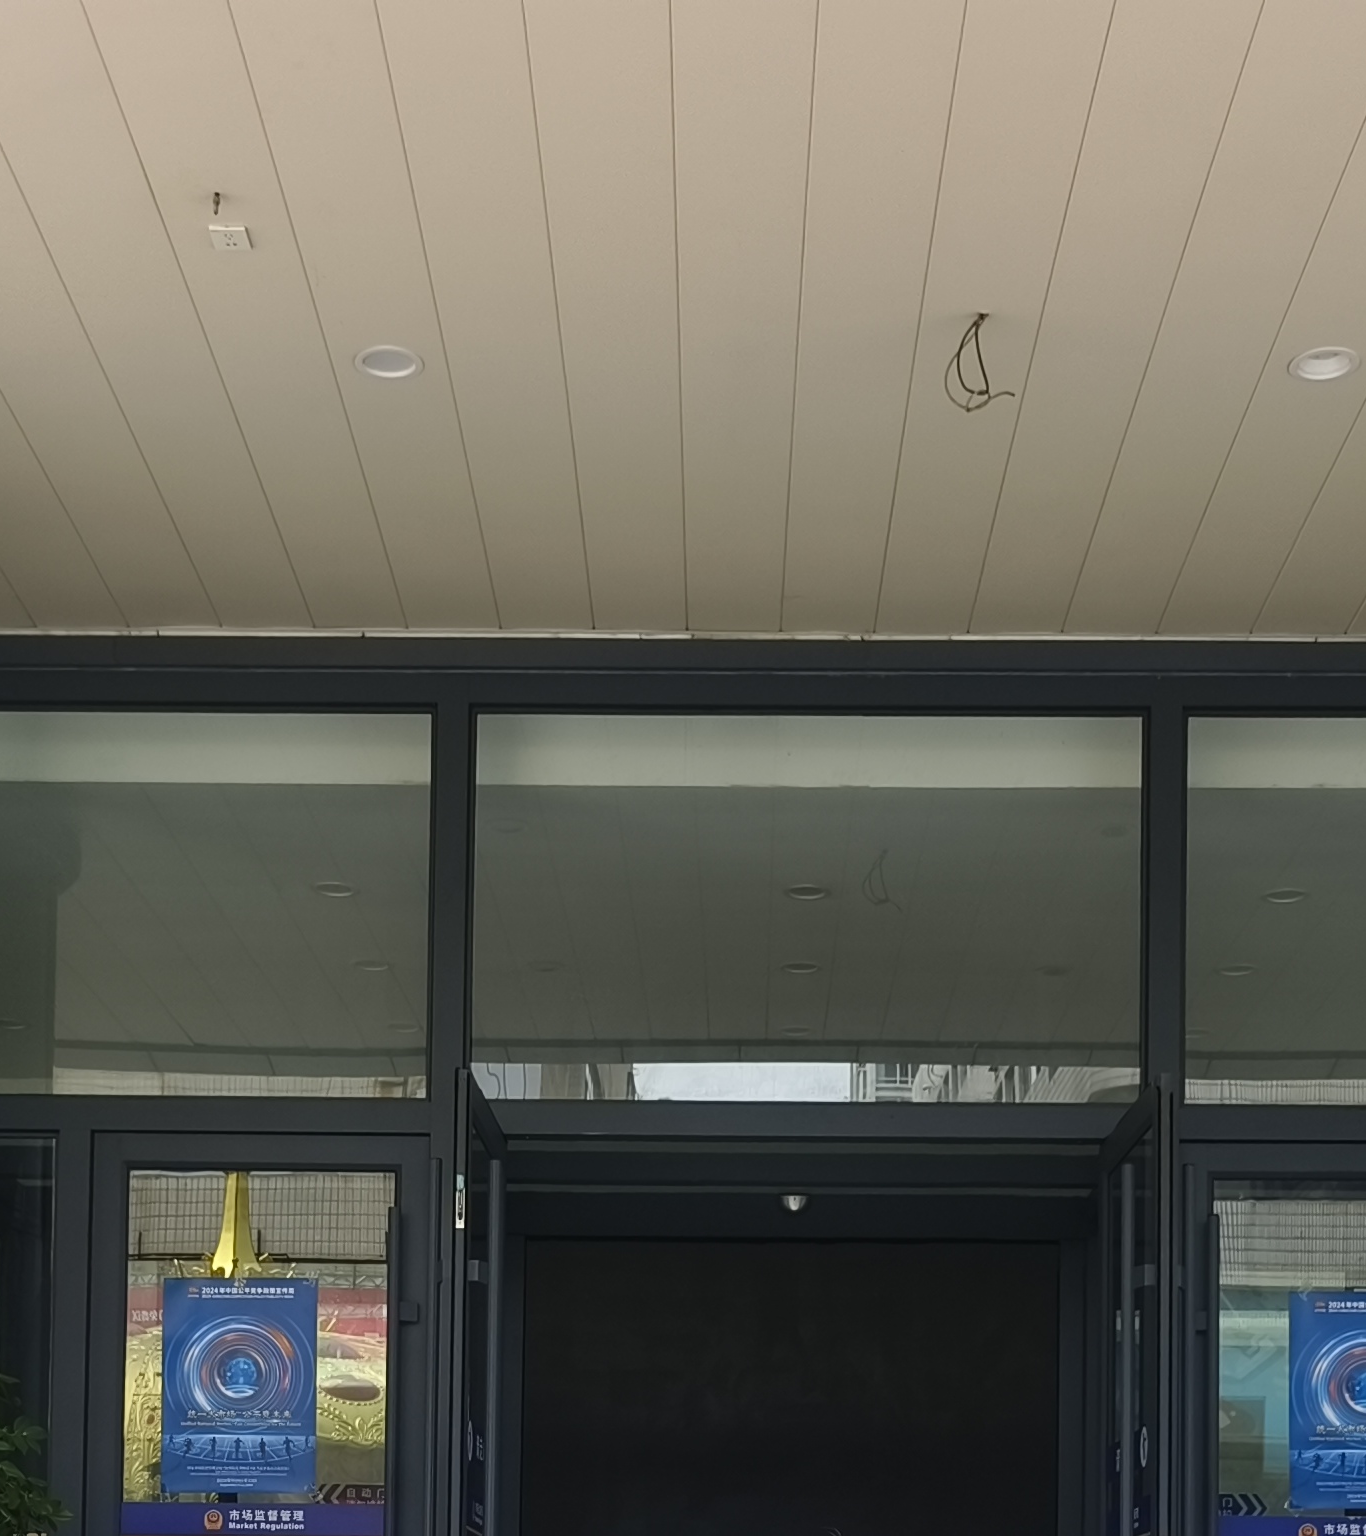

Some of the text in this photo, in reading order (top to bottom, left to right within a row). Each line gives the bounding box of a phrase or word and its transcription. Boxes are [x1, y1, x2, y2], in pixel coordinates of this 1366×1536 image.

[228, 1509, 305, 1522] 市场监督管理
[228, 1521, 305, 1532] Market Regulation
